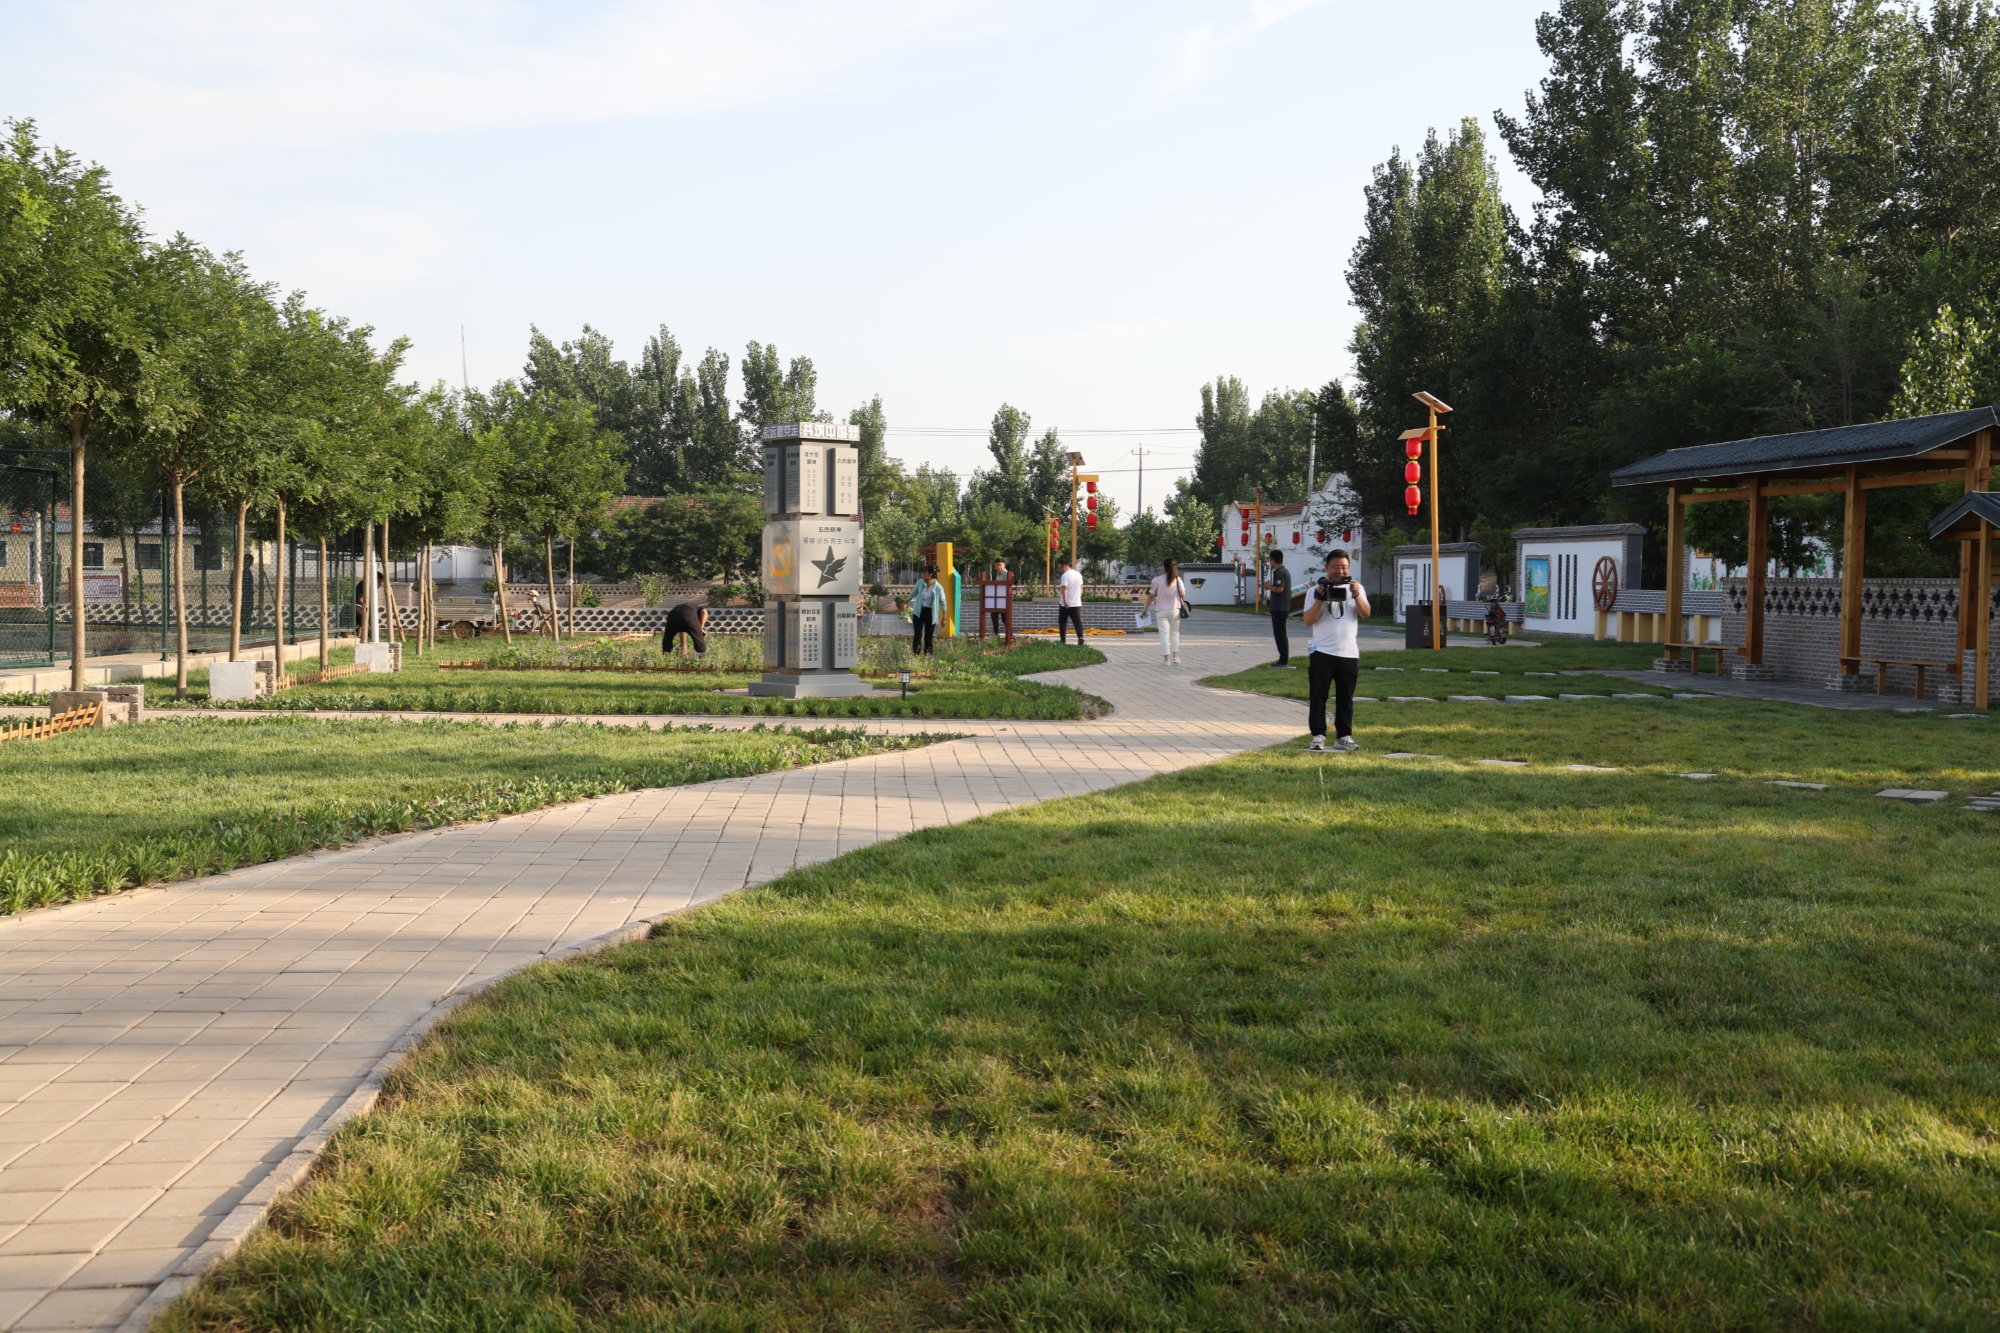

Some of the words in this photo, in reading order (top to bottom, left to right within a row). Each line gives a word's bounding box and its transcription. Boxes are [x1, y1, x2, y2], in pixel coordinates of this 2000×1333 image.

[763, 424, 799, 439] 永远跟党走
[802, 423, 858, 439] 共筑中国梦
